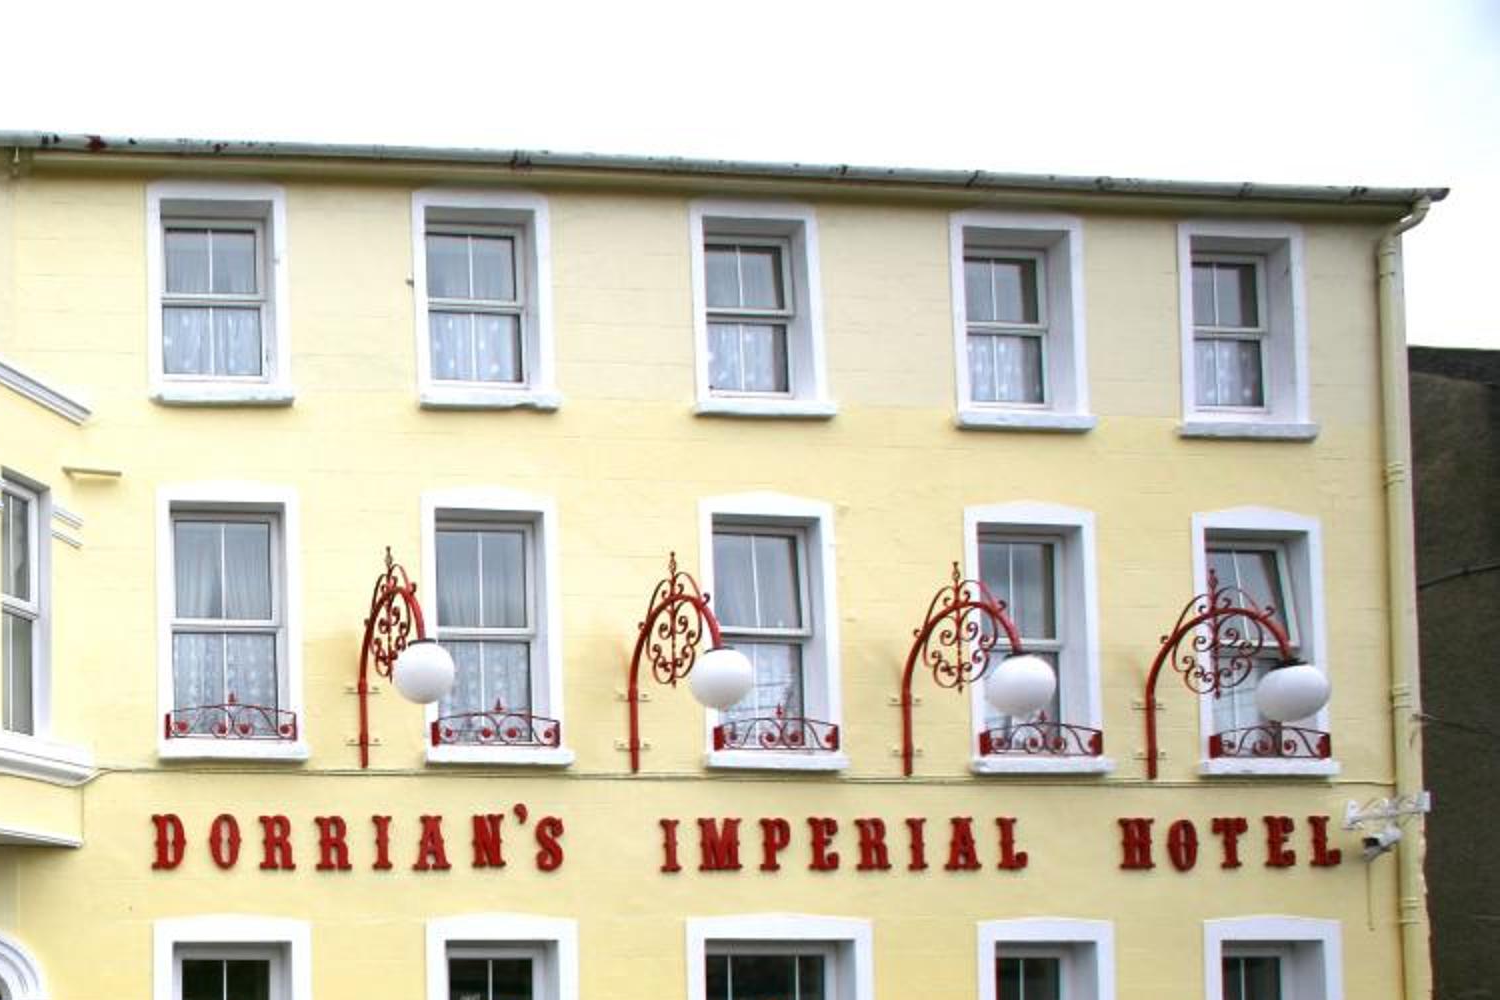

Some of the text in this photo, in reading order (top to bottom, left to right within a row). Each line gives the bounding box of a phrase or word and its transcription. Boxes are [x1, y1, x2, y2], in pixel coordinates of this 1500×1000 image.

[151, 802, 1342, 874] DORRIAN'S IMPERIAL HOTEL
